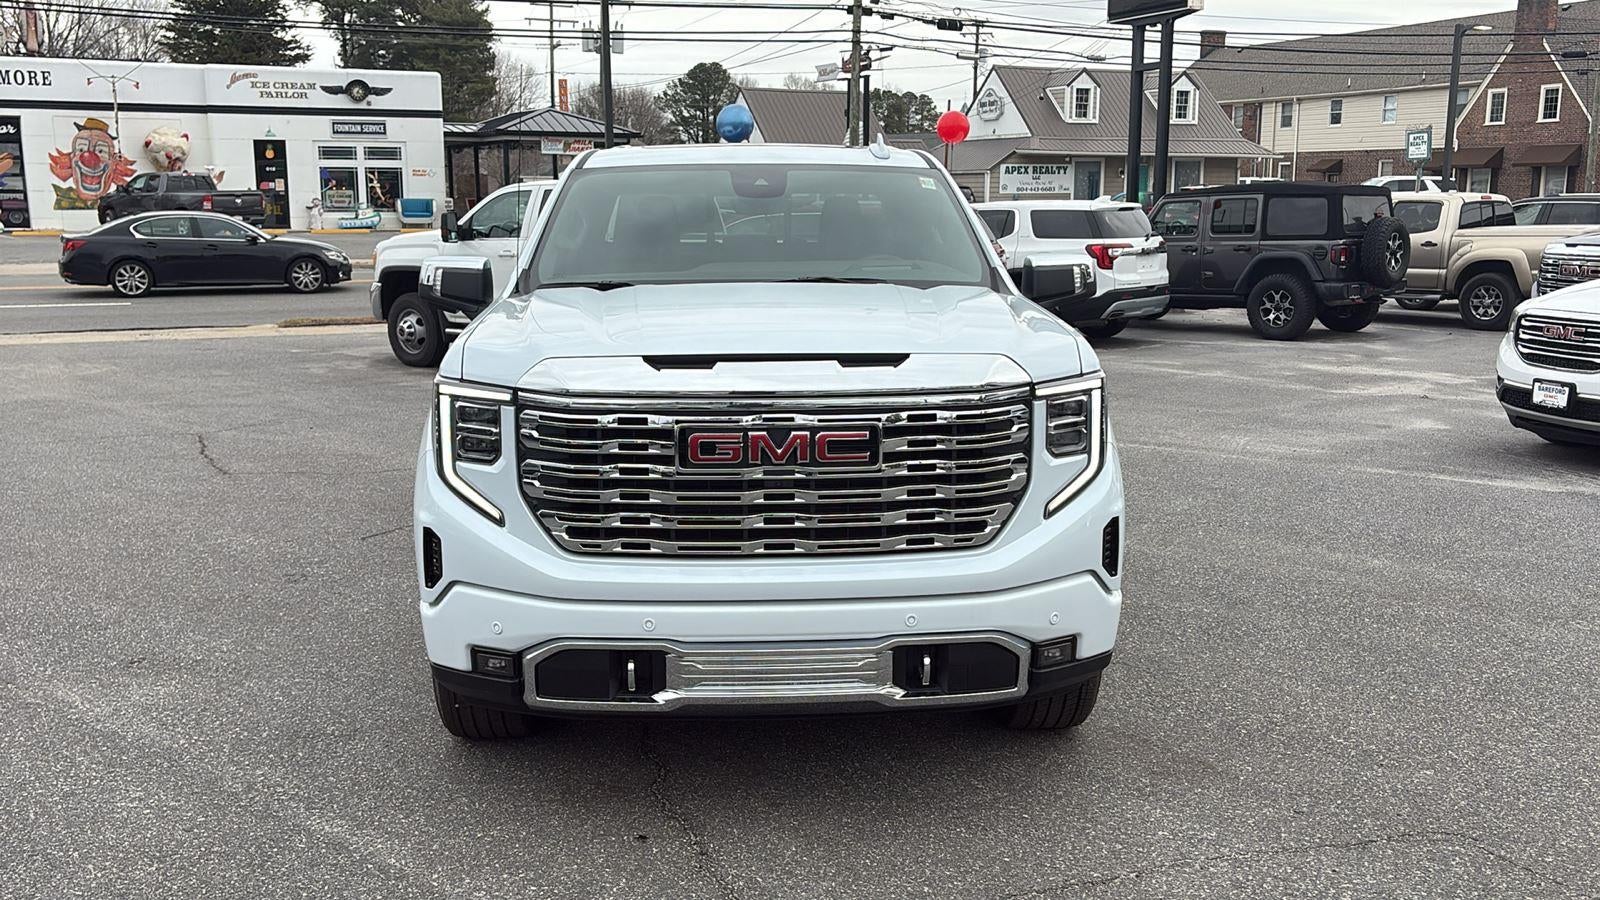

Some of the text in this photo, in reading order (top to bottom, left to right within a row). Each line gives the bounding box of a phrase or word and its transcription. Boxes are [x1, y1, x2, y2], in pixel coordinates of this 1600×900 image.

[0, 69, 52, 86] MORE
[250, 81, 316, 90] ICE CREAM
[260, 90, 308, 99] PARLOR
[334, 124, 385, 133] FOUNTAIN SERVICE
[1004, 165, 1069, 175] APEX REALTY
[1562, 265, 1600, 277] GMC
[1543, 325, 1585, 341] GMC
[1537, 385, 1567, 395] BAREFORD
[688, 431, 870, 464] GMC
